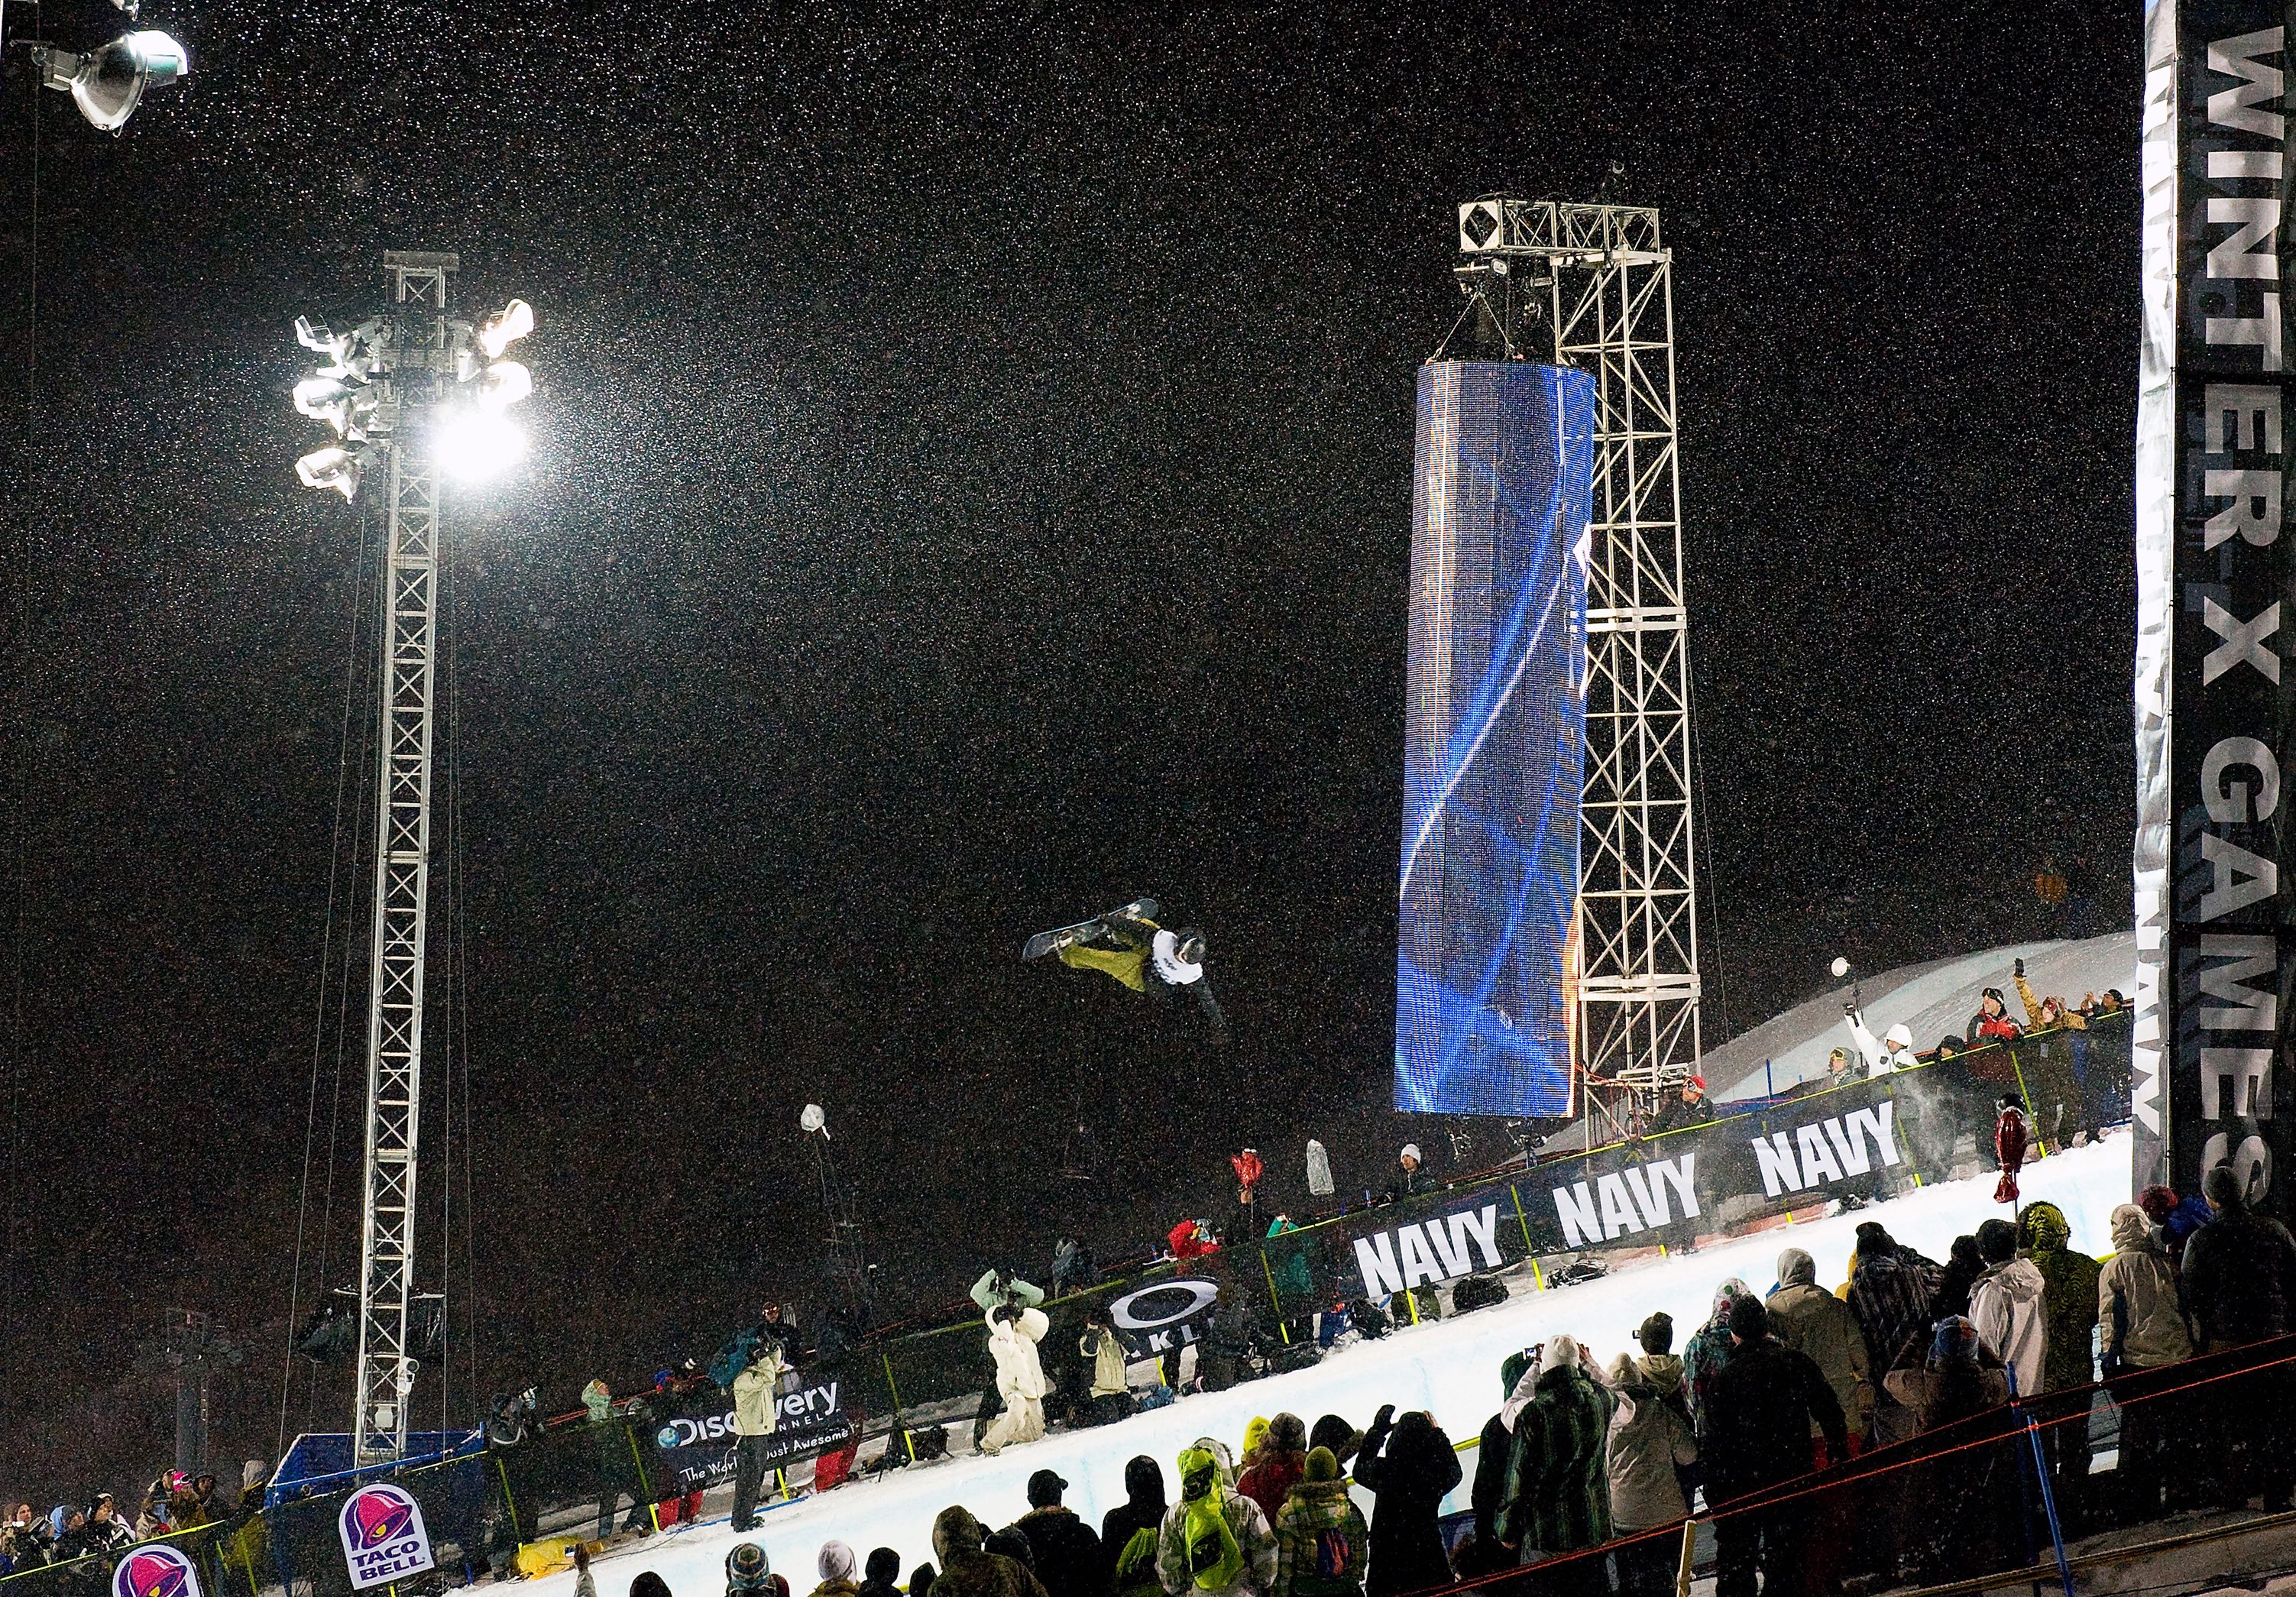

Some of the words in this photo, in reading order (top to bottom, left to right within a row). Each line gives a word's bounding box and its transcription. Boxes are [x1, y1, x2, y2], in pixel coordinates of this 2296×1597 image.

[2205, 26, 2285, 551] WINTER
[2204, 596, 2280, 686] X
[2200, 736, 2280, 1207] GAMES
[1751, 1100, 1900, 1197] NAVY
[1552, 1152, 1701, 1249] NAVY
[1353, 1204, 1503, 1299] NAVY
[679, 1466, 707, 1482] The
[708, 1456, 738, 1475] Worl
[793, 1429, 849, 1453] Awesome
[351, 1540, 420, 1568] TACO
[359, 1555, 426, 1581] BELL
